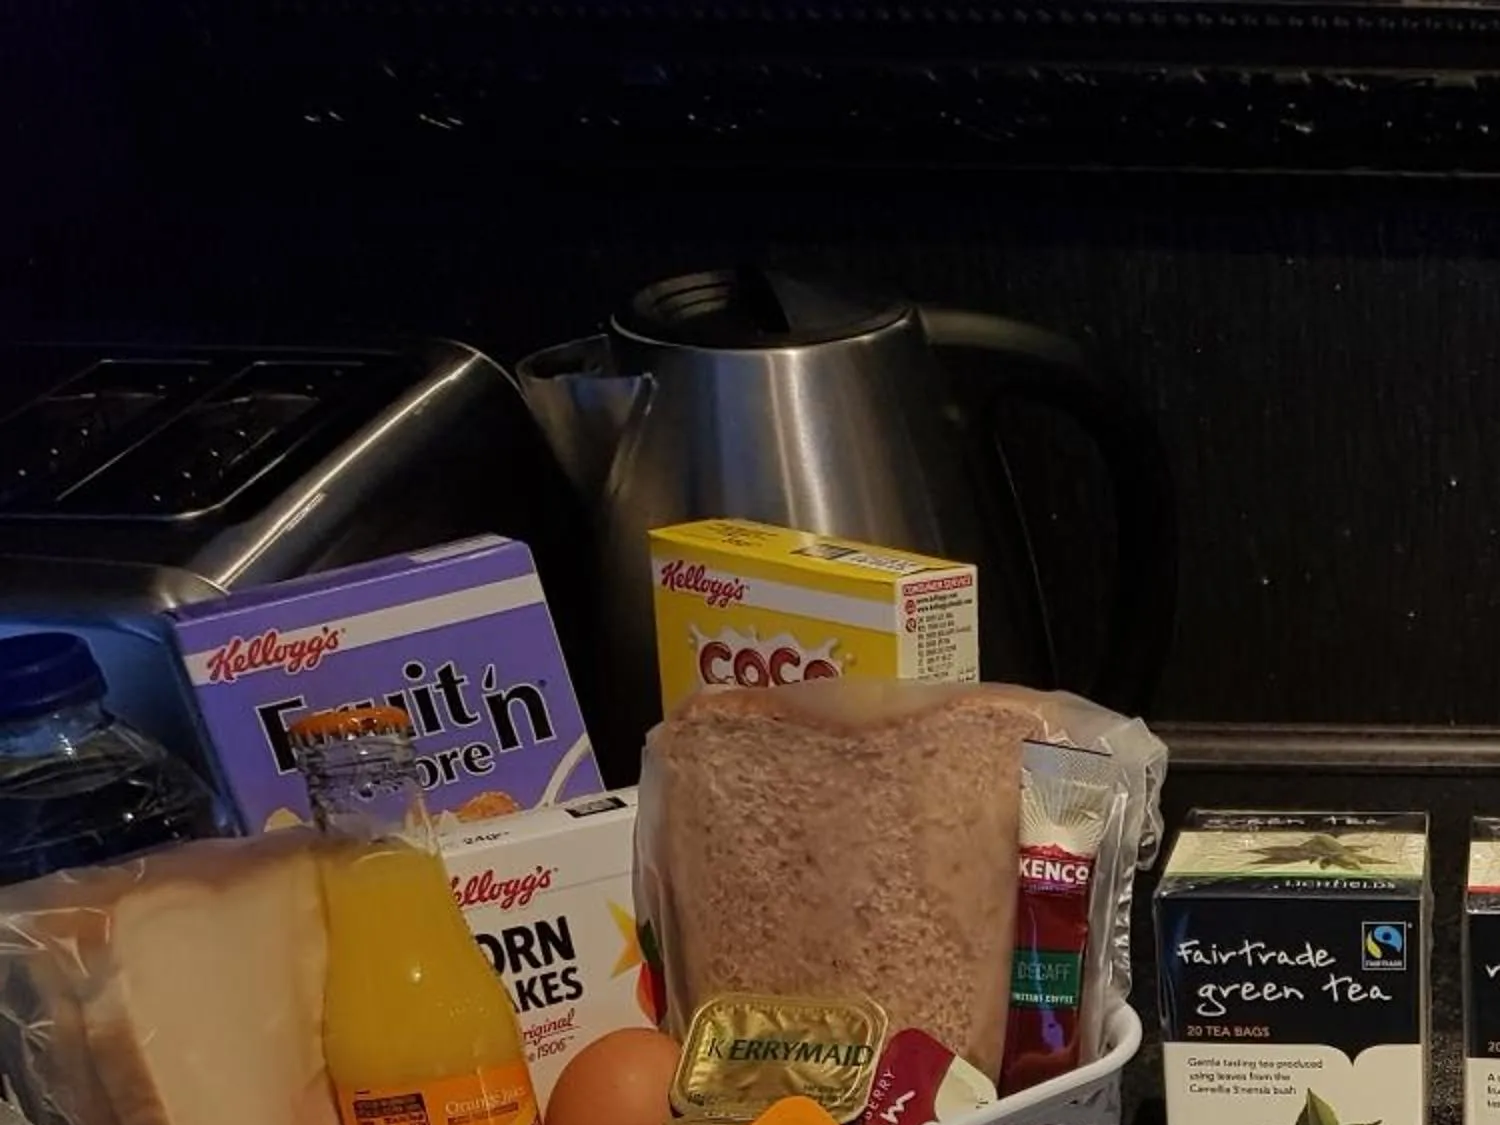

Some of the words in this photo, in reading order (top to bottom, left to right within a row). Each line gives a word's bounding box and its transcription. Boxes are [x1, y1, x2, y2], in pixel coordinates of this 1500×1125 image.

[660, 558, 748, 609] Kellogg's
[207, 626, 341, 681] Kellogg's
[256, 661, 480, 774] Fit
[450, 864, 554, 909] ellogg's
[1018, 856, 1089, 885] KENCO
[506, 966, 584, 1014] KES
[1196, 981, 1305, 1018] green
[1321, 972, 1393, 1003] tea
[522, 1008, 578, 1047] riginal
[1186, 1024, 1203, 1038] 20
[1206, 1025, 1232, 1038] TEA
[1233, 1025, 1272, 1038] BAGS
[707, 1036, 875, 1068] KERRYMAID
